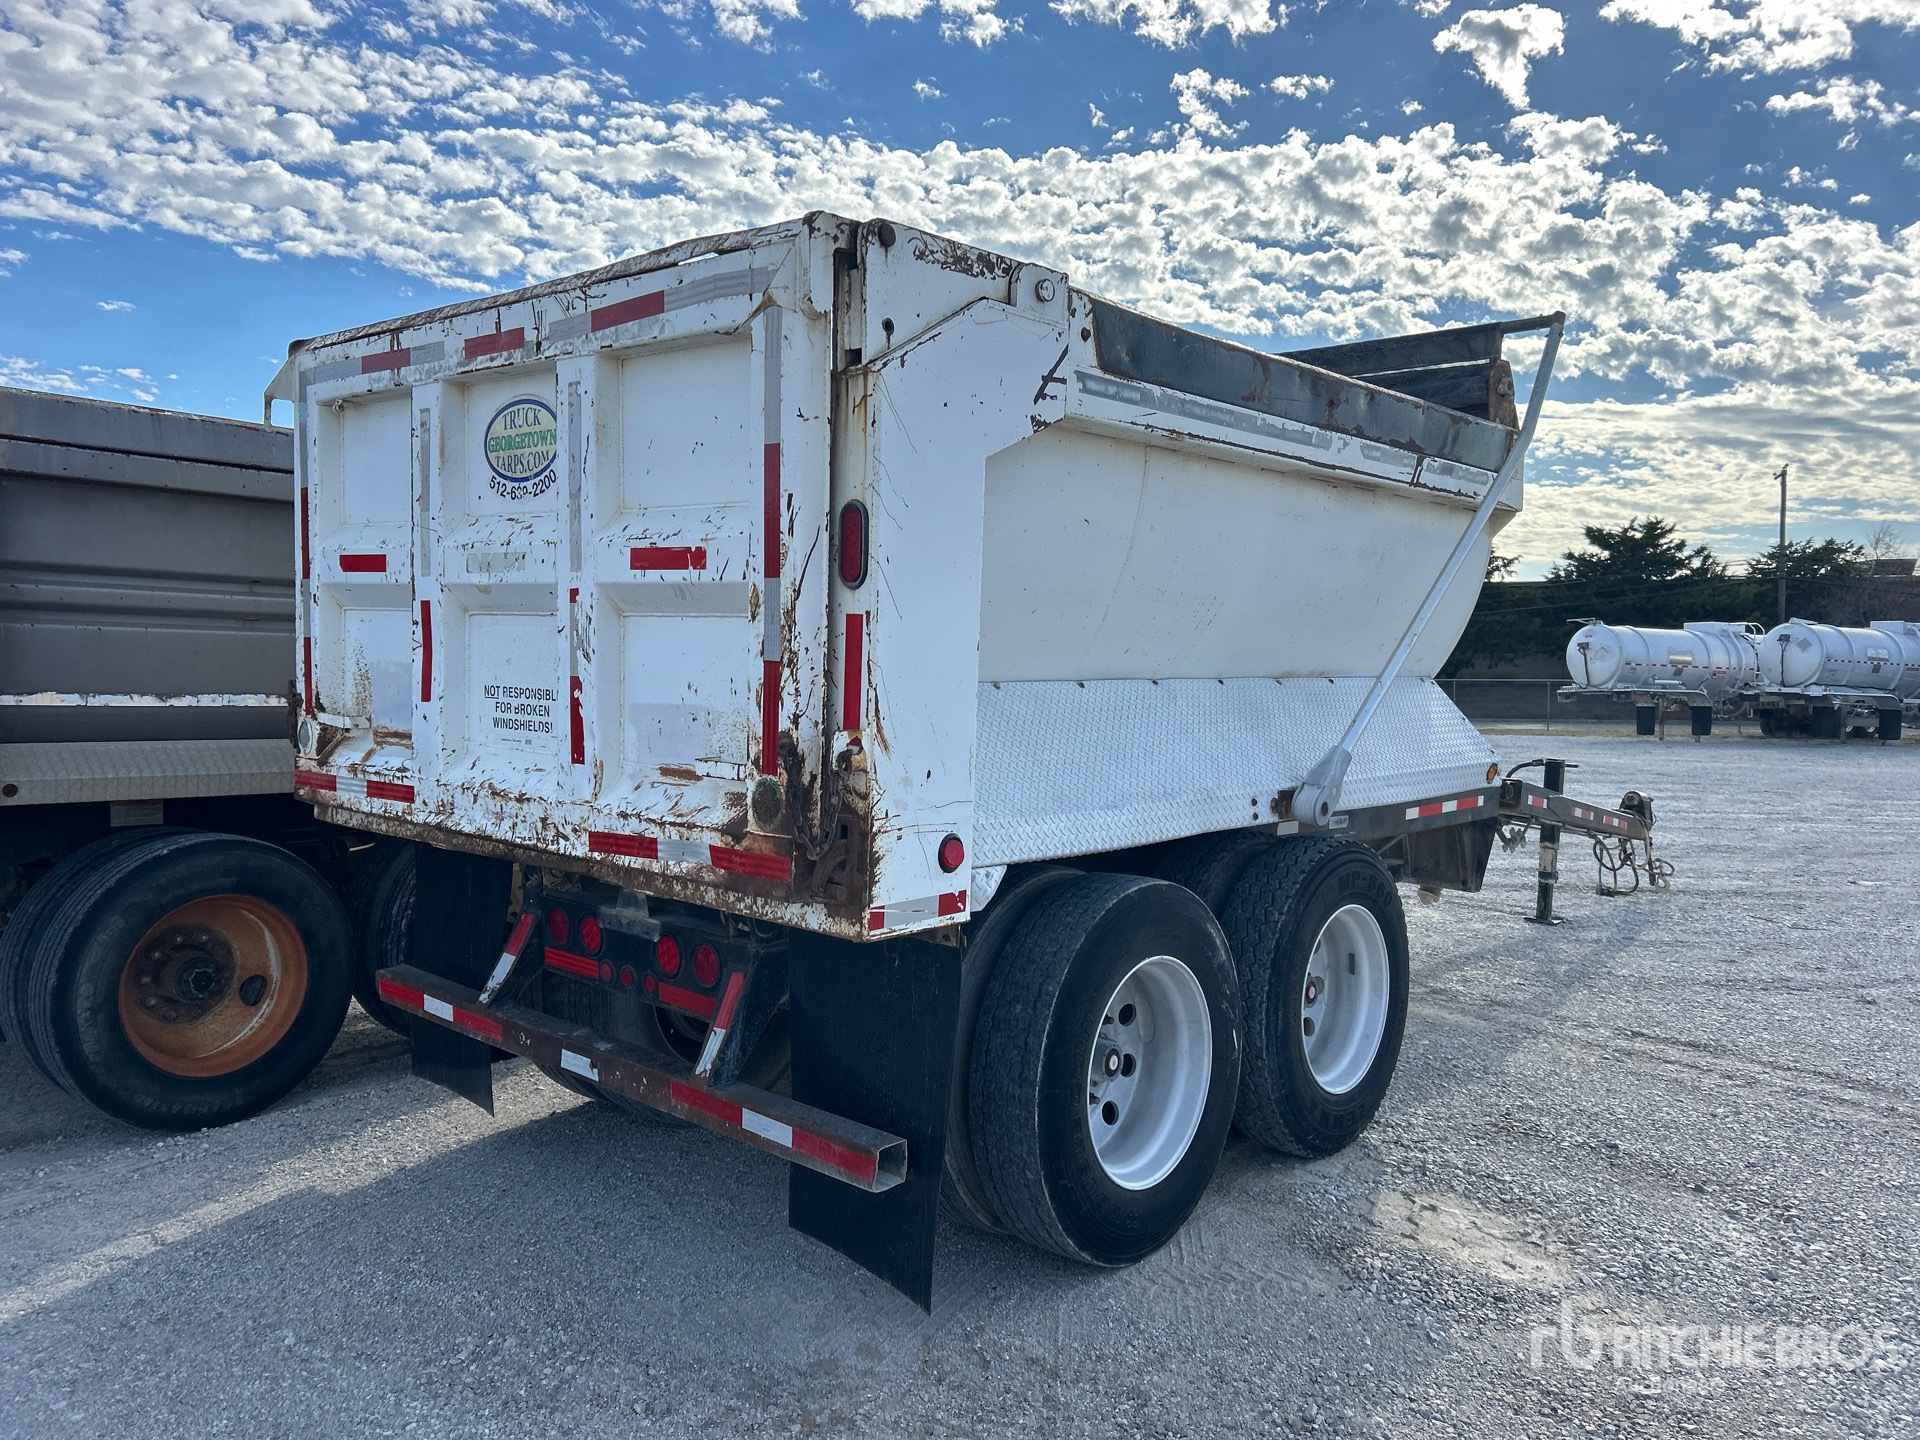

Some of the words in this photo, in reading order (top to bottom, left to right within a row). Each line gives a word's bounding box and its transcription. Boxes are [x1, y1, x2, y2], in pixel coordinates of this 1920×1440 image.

[502, 407, 541, 430] TRUCK
[488, 429, 557, 453] GEORGETOWN
[495, 450, 550, 474] TARPS.COM
[484, 685, 501, 699] NOT
[495, 701, 512, 714] FOR
[514, 703, 550, 717] BROKEN
[492, 717, 553, 734] WINDSHIELDS!
